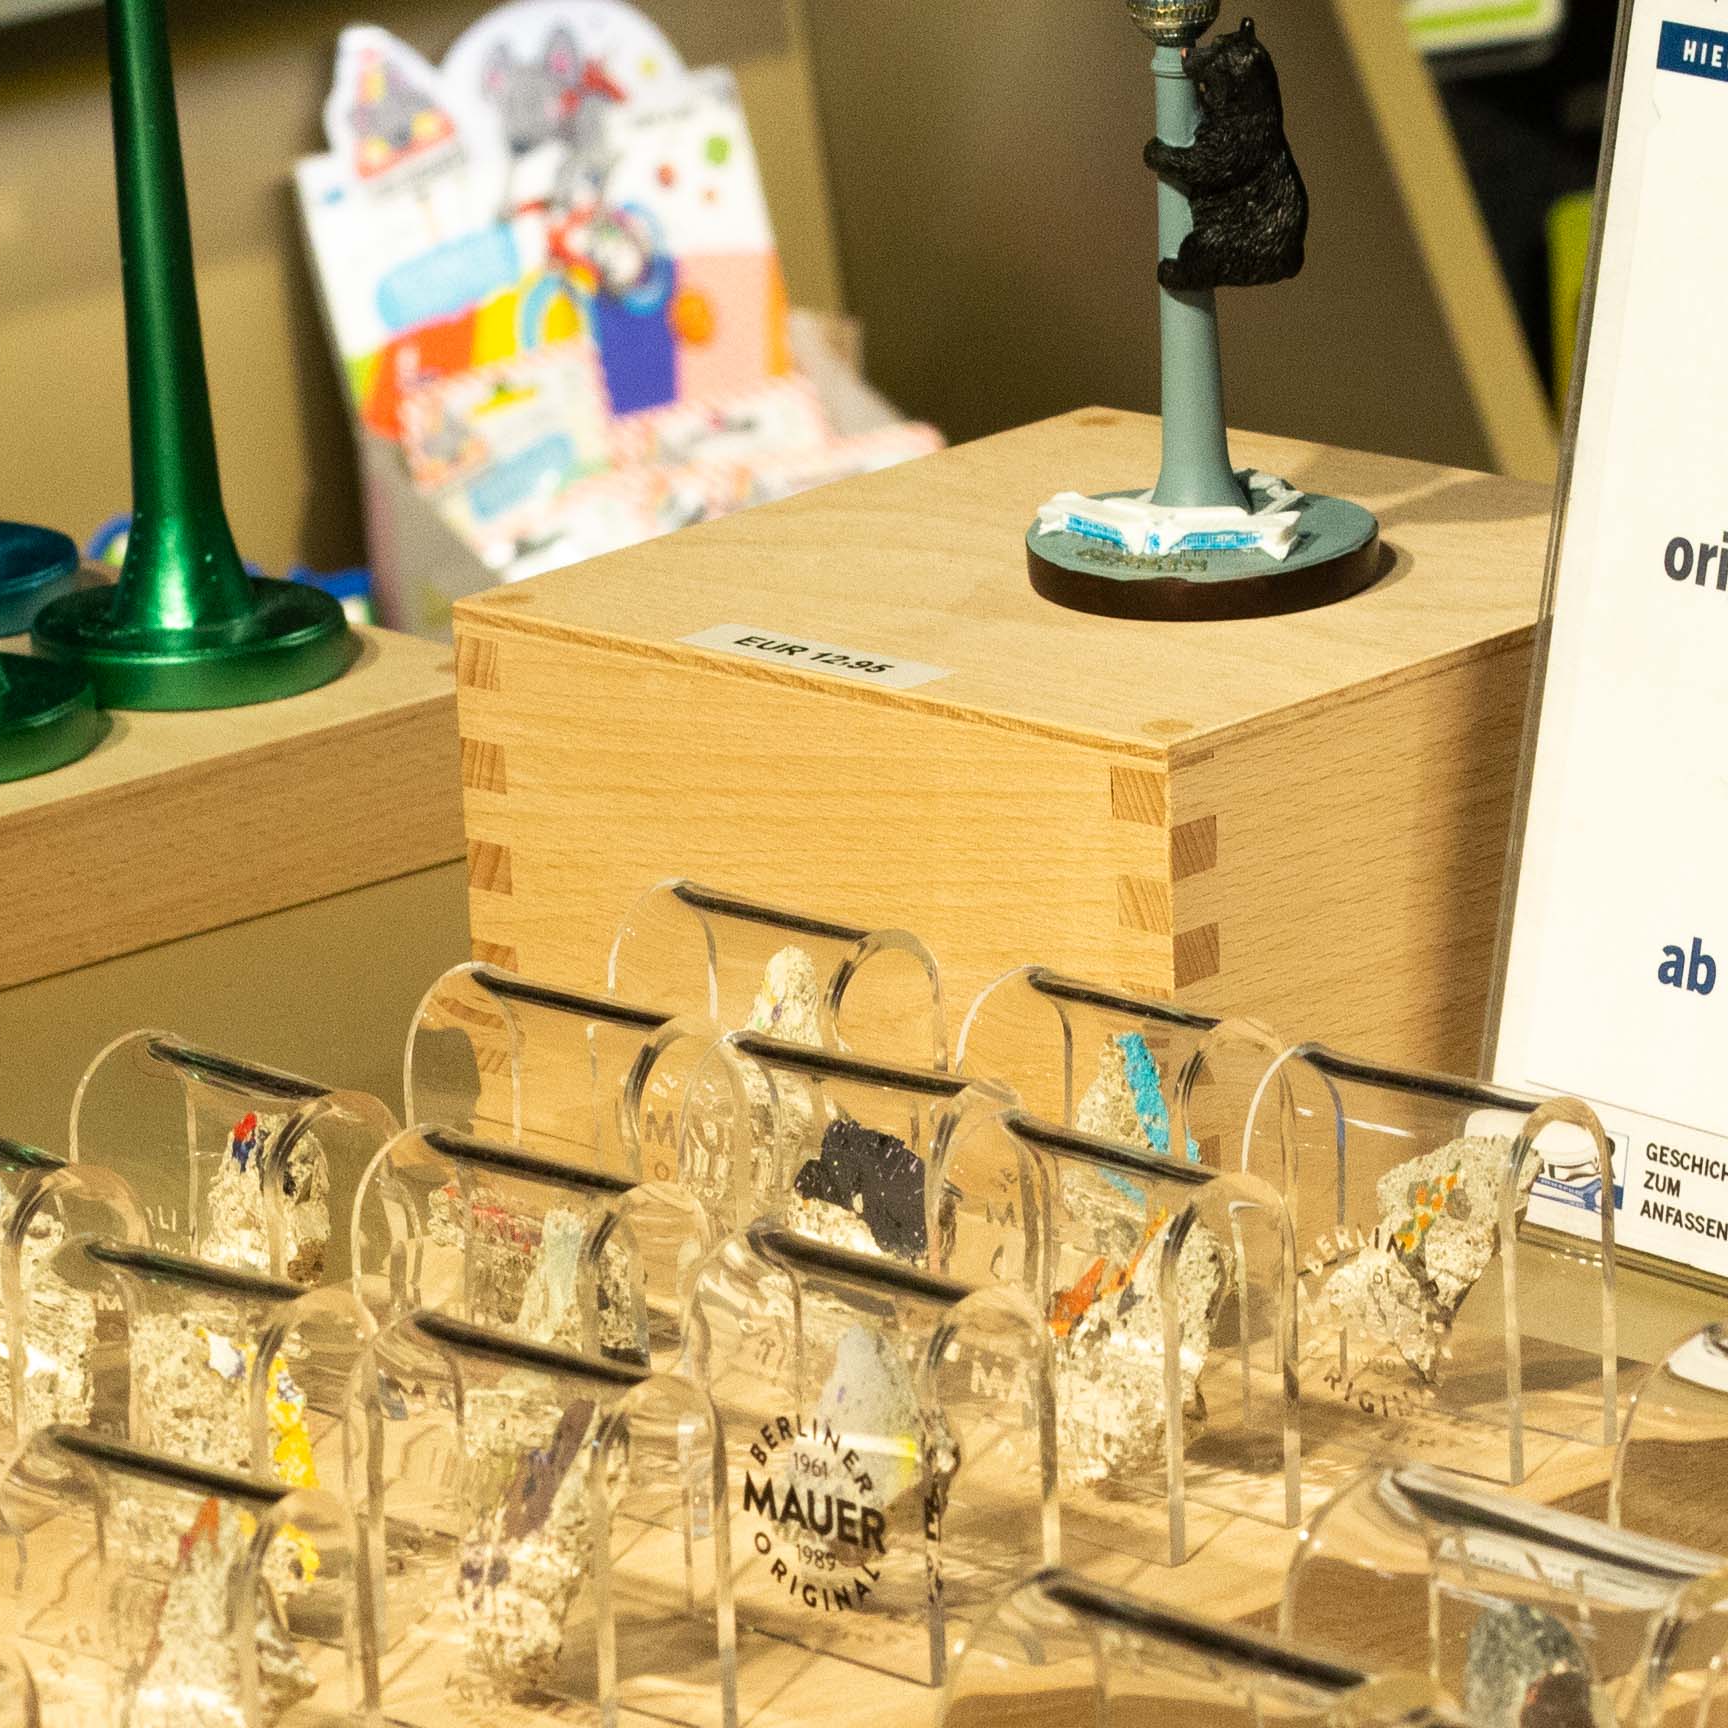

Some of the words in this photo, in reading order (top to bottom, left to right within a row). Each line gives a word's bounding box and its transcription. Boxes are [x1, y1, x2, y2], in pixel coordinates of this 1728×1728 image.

[734, 635, 809, 656] EUR
[1658, 937, 1717, 995] ab
[1642, 1170, 1682, 1198] ZUM
[749, 1414, 873, 1494] BERLINER
[793, 1452, 829, 1480] 1961
[743, 1470, 887, 1554] MAUER
[754, 1531, 880, 1611] ORIGINAL
[795, 1544, 837, 1572] 1989
